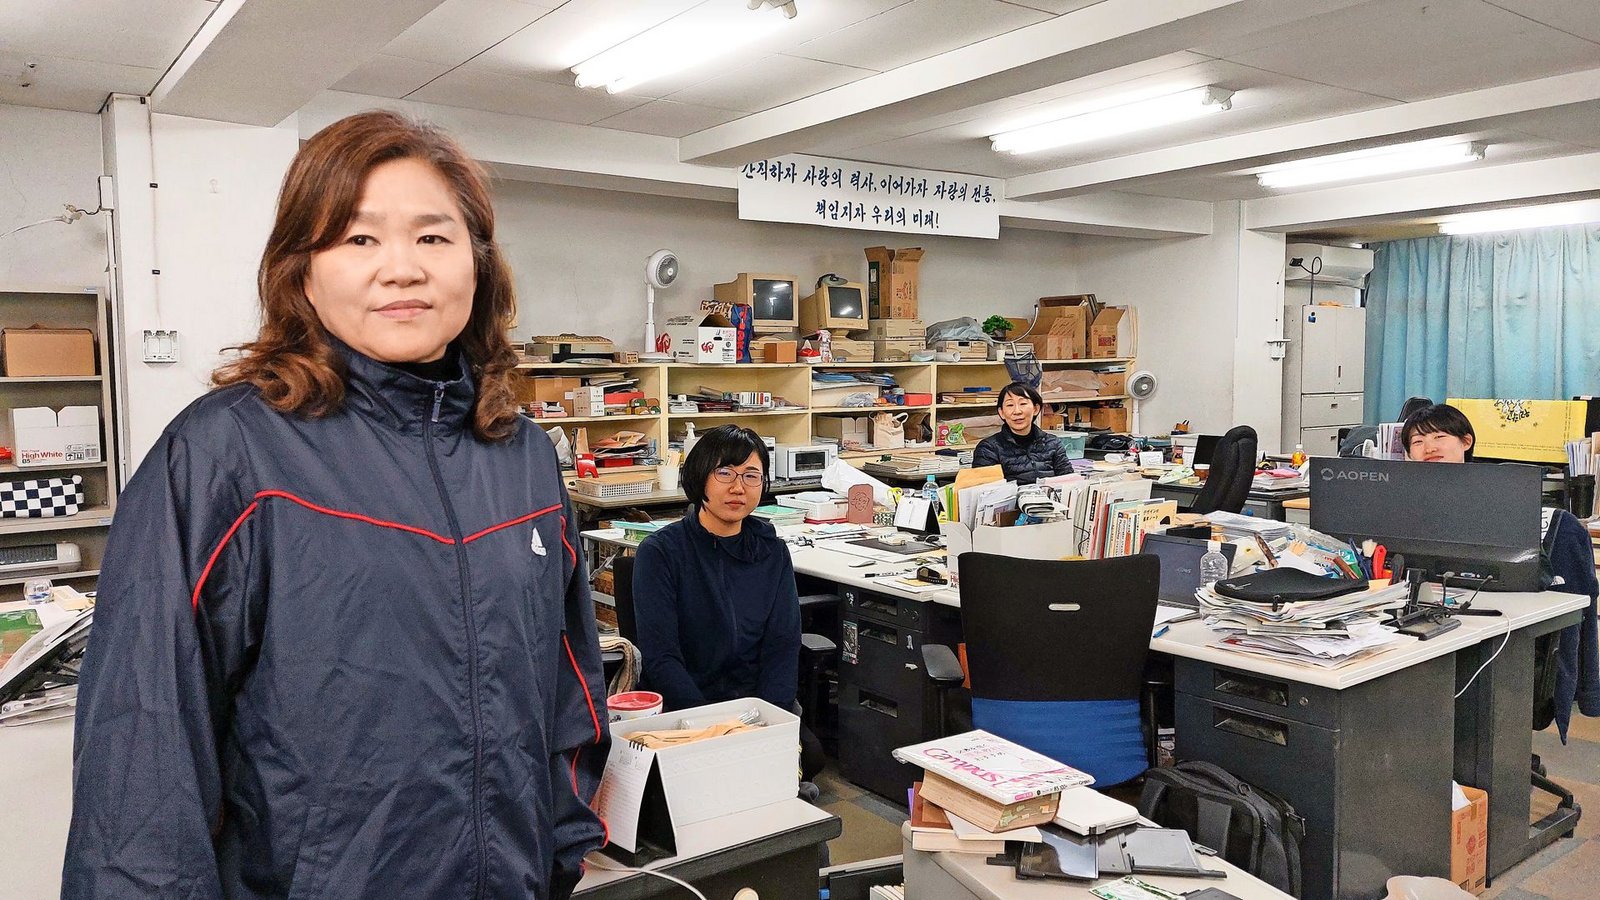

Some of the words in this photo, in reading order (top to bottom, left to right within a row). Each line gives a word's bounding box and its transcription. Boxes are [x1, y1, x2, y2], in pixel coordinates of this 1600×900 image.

[803, 165, 842, 189] 사랑의
[933, 181, 968, 202] 자랑의
[971, 185, 996, 203] 전통,
[815, 199, 866, 223] 책임지자
[872, 205, 906, 227] 우리의
[912, 208, 939, 229] 미래!
[21, 452, 39, 460] High
[40, 451, 63, 459] White
[1336, 470, 1389, 482] AOPEN
[922, 748, 1004, 783] Campus
